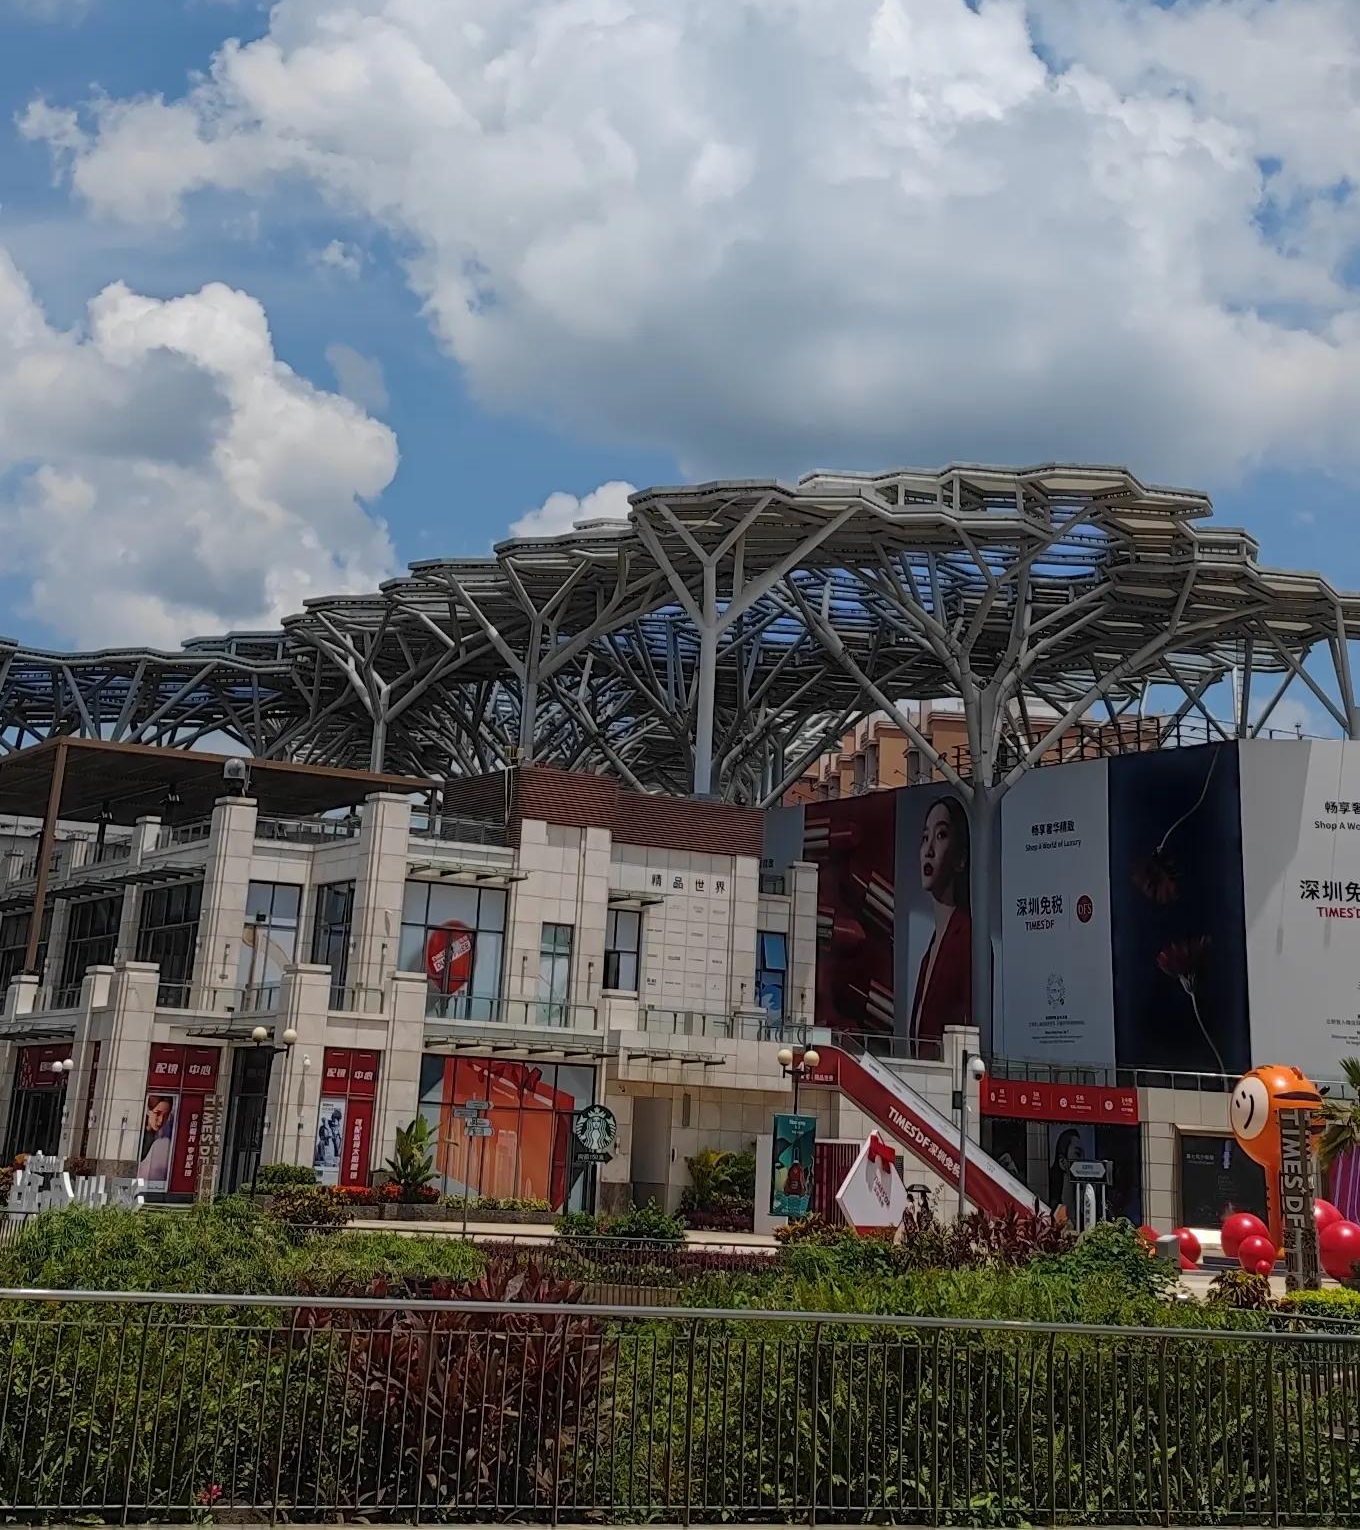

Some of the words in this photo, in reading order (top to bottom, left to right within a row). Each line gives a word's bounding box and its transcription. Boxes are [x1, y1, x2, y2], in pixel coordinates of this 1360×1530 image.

[1314, 821, 1337, 831] Shop
[1339, 822, 1346, 830] A
[651, 874, 726, 894] 精品世界
[1016, 895, 1063, 916] 深圳免税
[1078, 903, 1093, 915] DFS
